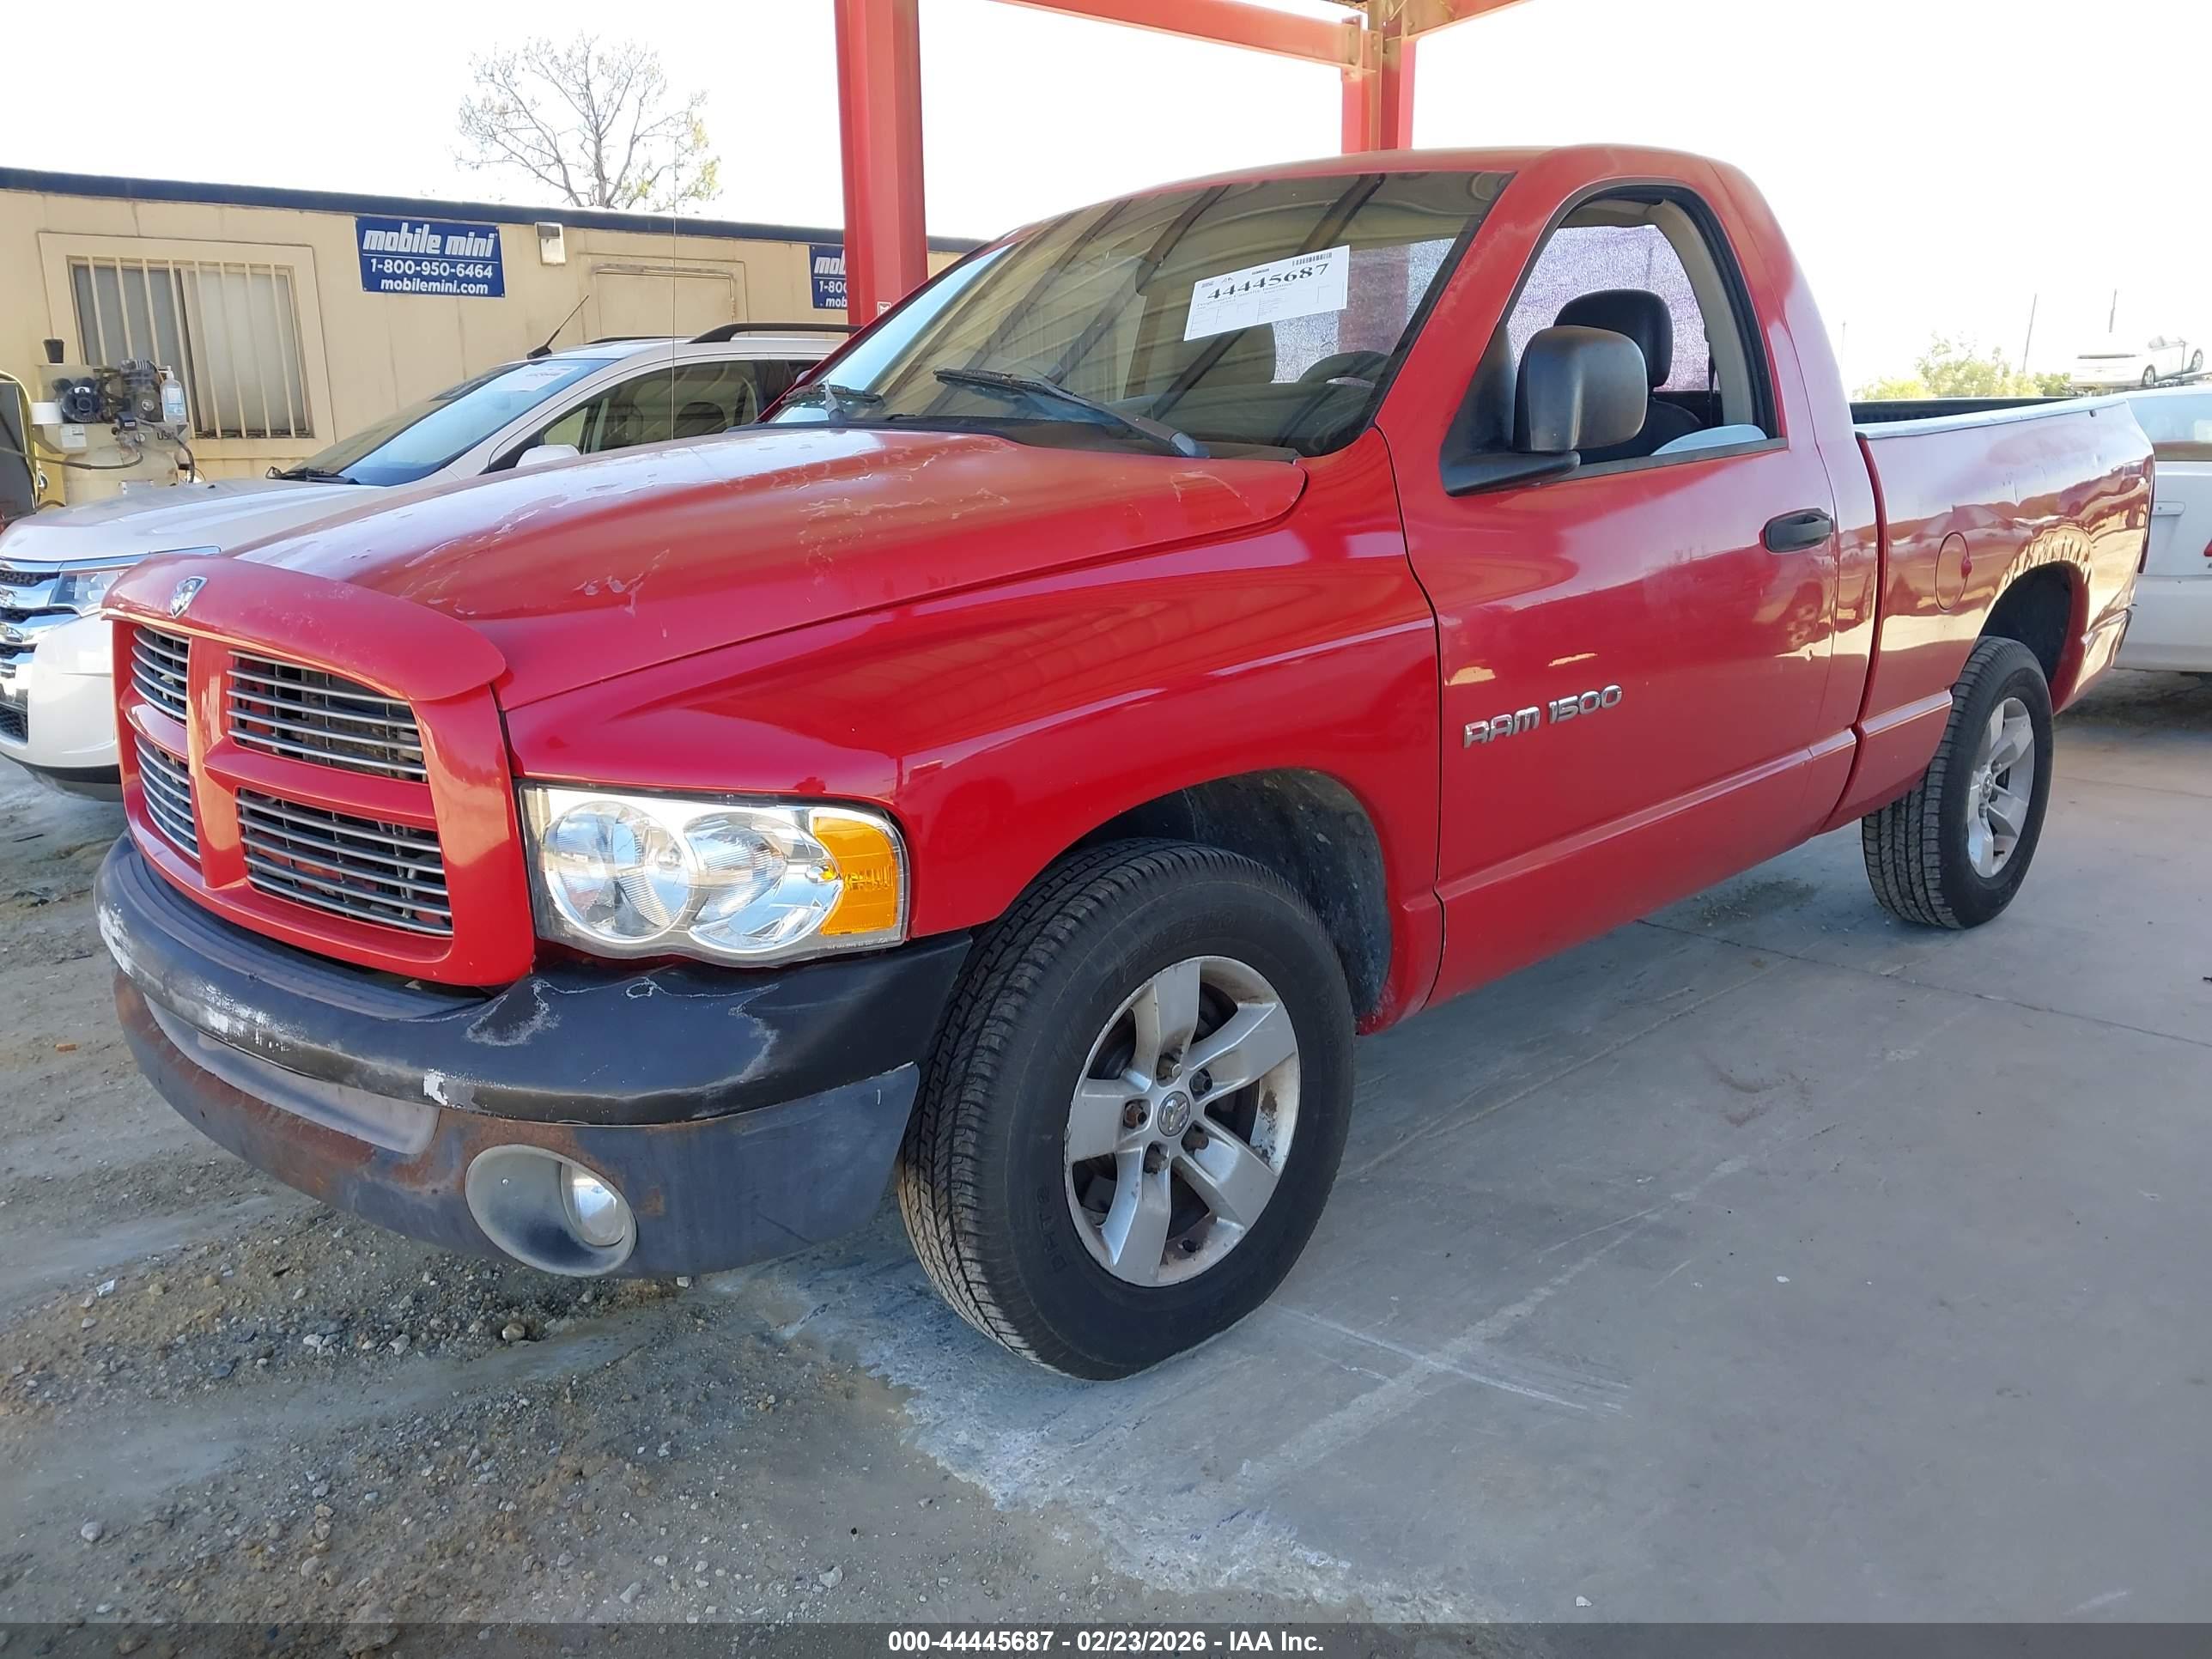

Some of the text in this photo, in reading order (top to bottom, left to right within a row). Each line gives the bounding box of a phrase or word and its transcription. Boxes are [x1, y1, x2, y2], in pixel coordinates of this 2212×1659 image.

[362, 222, 495, 257] mobile mini
[369, 258, 493, 279] 1-800-950-6464
[380, 277, 489, 295] mobilemini.com
[1206, 263, 1329, 300] 44445687
[1464, 684, 1623, 749] RAM 1500
